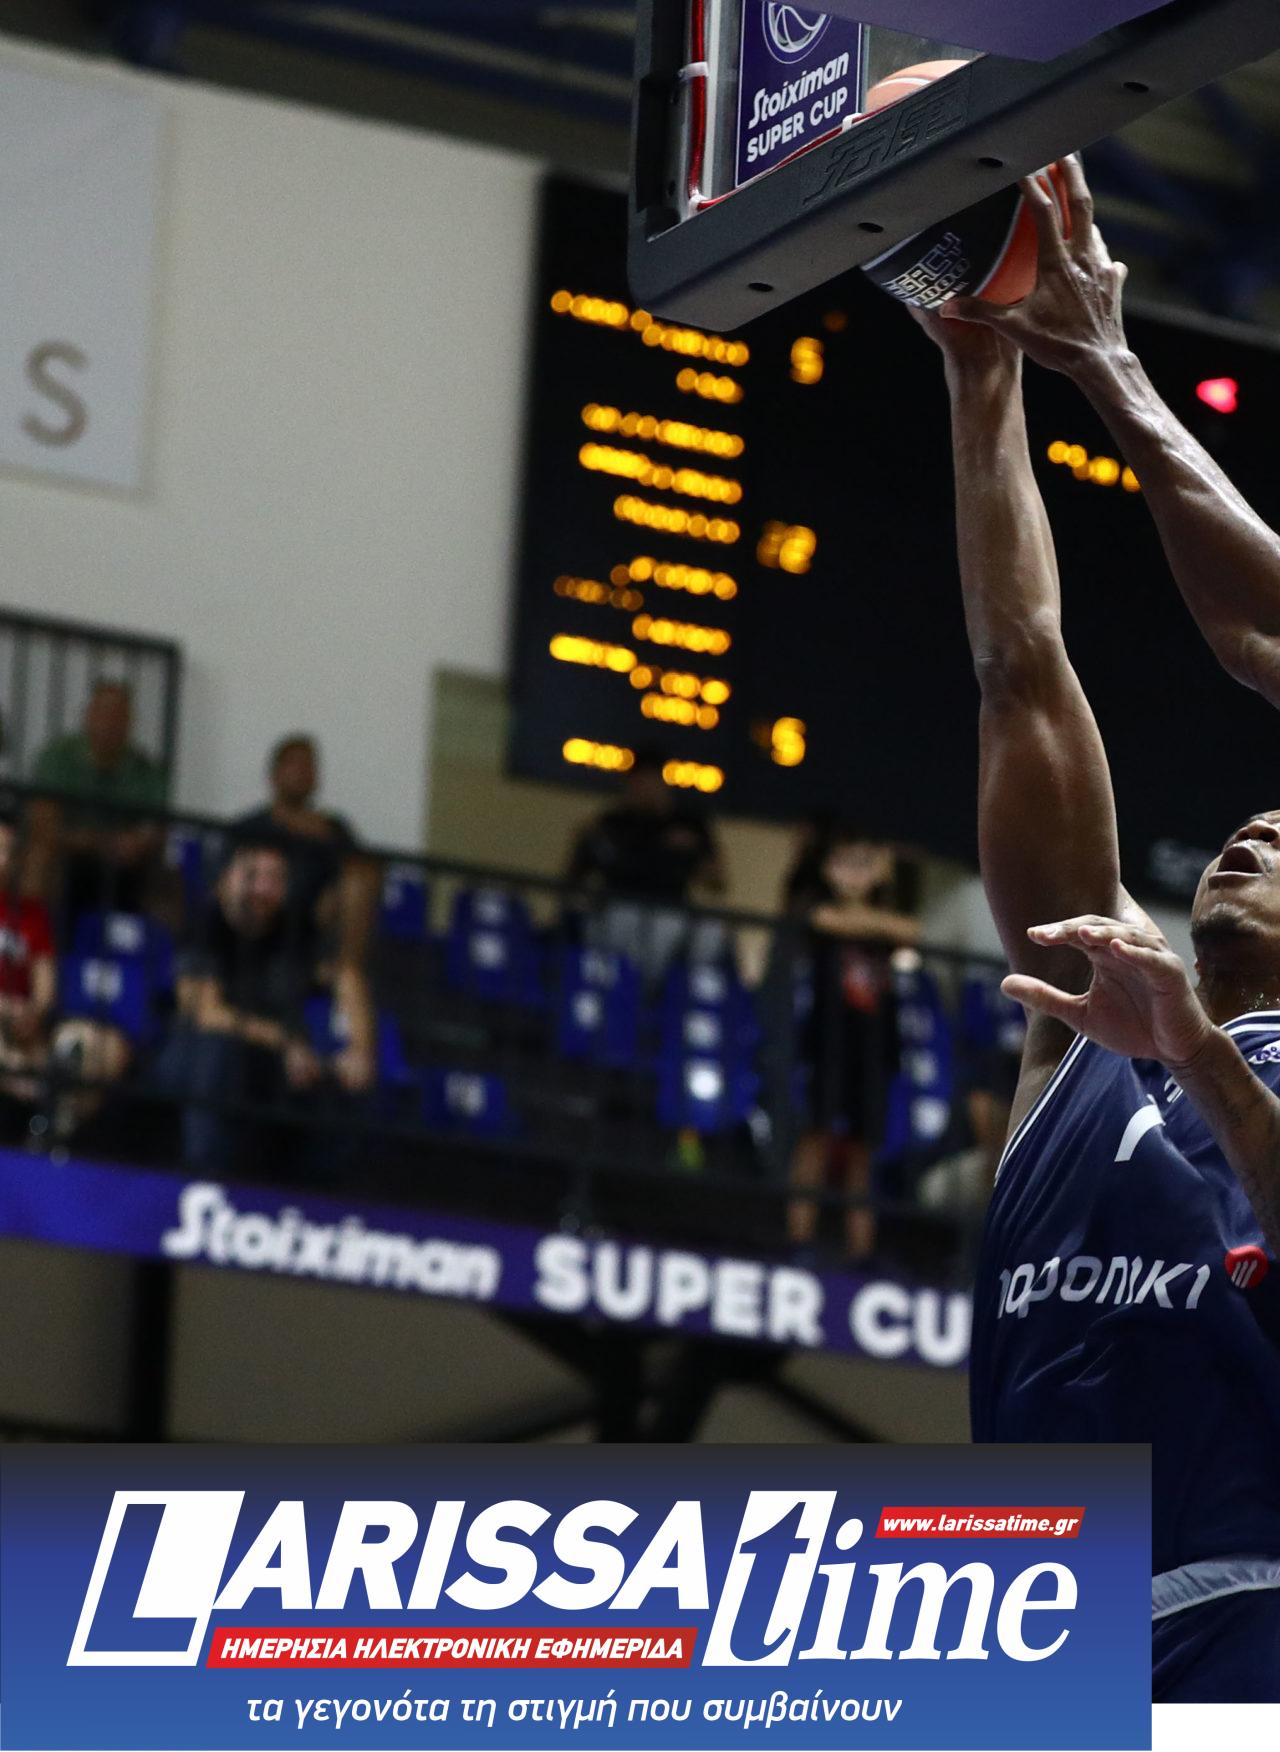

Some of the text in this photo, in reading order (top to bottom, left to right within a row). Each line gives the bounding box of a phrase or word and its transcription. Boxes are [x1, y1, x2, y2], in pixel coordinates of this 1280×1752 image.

[747, 86, 848, 162] SUPER CUP
[748, 52, 849, 130] Stoiximan
[161, 1182, 972, 1367] Stoiximan SUPER CU
